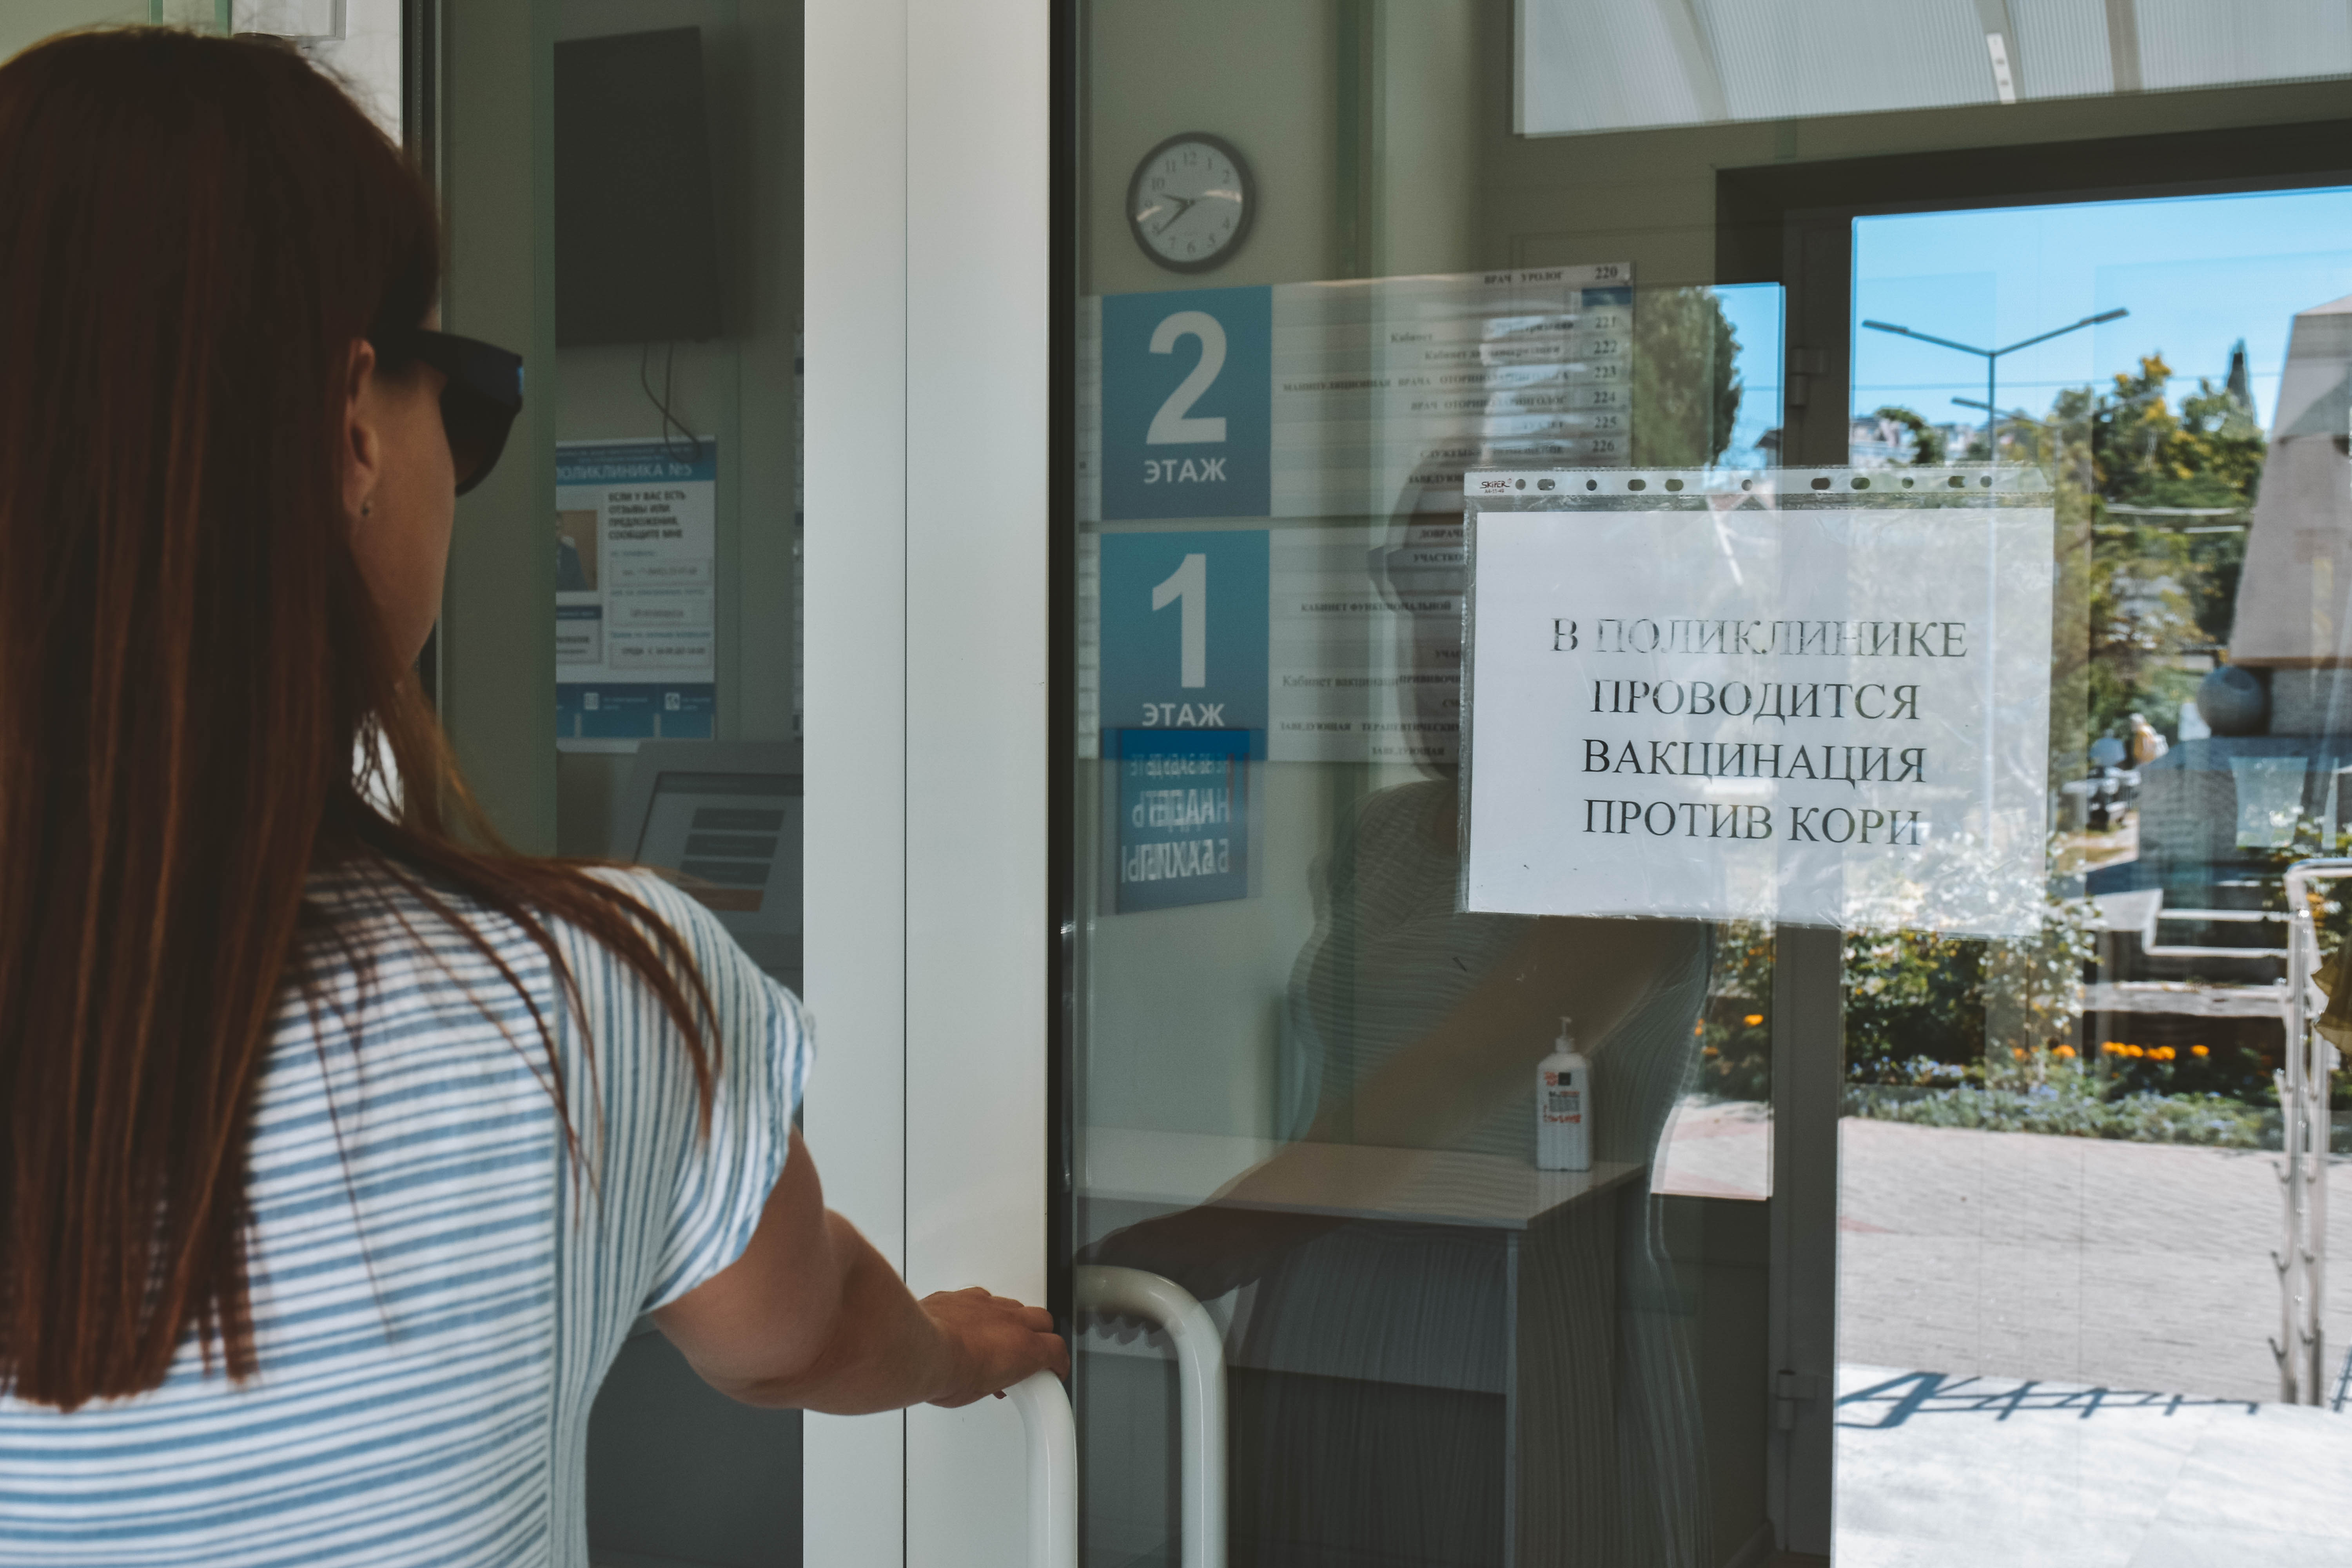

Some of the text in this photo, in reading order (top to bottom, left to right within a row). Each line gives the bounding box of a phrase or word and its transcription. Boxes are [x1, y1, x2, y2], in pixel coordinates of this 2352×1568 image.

[1183, 152, 1197, 166] 12
[1208, 157, 1212, 171] 1
[1166, 160, 1176, 173] 11
[1222, 169, 1230, 184] 2
[1152, 177, 1165, 191] 10
[1222, 217, 1230, 230] 4
[1207, 233, 1216, 247] 5
[1187, 241, 1196, 255] 6
[1484, 267, 1618, 284] ВРАЧ УРОЛОГ 220
[1595, 316, 1616, 329] 221
[1594, 340, 1617, 354] 222
[1146, 311, 1227, 445] 2
[1595, 365, 1616, 378] 223
[1594, 391, 1616, 404] 224
[1595, 416, 1617, 429] 225
[1593, 439, 1615, 452] 226
[1144, 457, 1227, 483] ЭТАЖ
[1152, 554, 1206, 688] 1
[1550, 618, 1968, 658] В ПОЛИКЛИНИКЕ
[1590, 679, 1921, 726] ПРОВОДИТСЯ
[1142, 702, 1225, 726] ЭТАЖ
[1581, 739, 1927, 789] ВАКЦИНАЦИЯ
[1582, 799, 1921, 846] ПРОТИВ КОРИ
